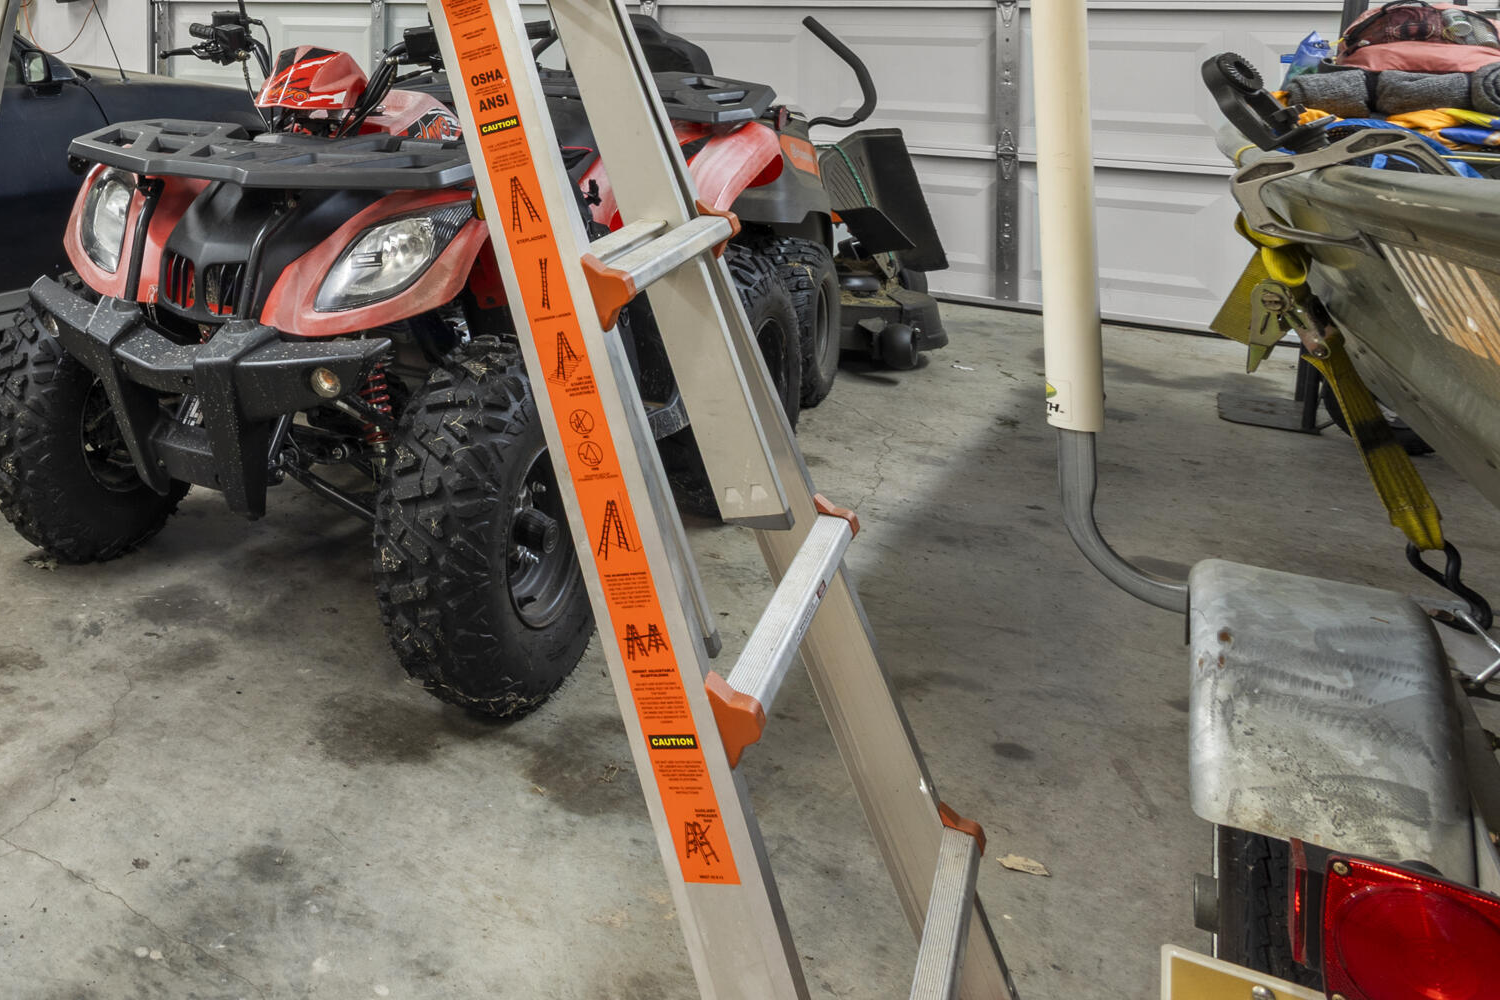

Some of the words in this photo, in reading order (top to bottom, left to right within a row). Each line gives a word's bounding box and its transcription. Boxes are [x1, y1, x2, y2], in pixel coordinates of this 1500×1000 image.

[470, 68, 503, 87] OSHA
[479, 93, 509, 113] ANSI
[482, 118, 517, 133] CAUTION
[651, 737, 694, 746] CAUTION
